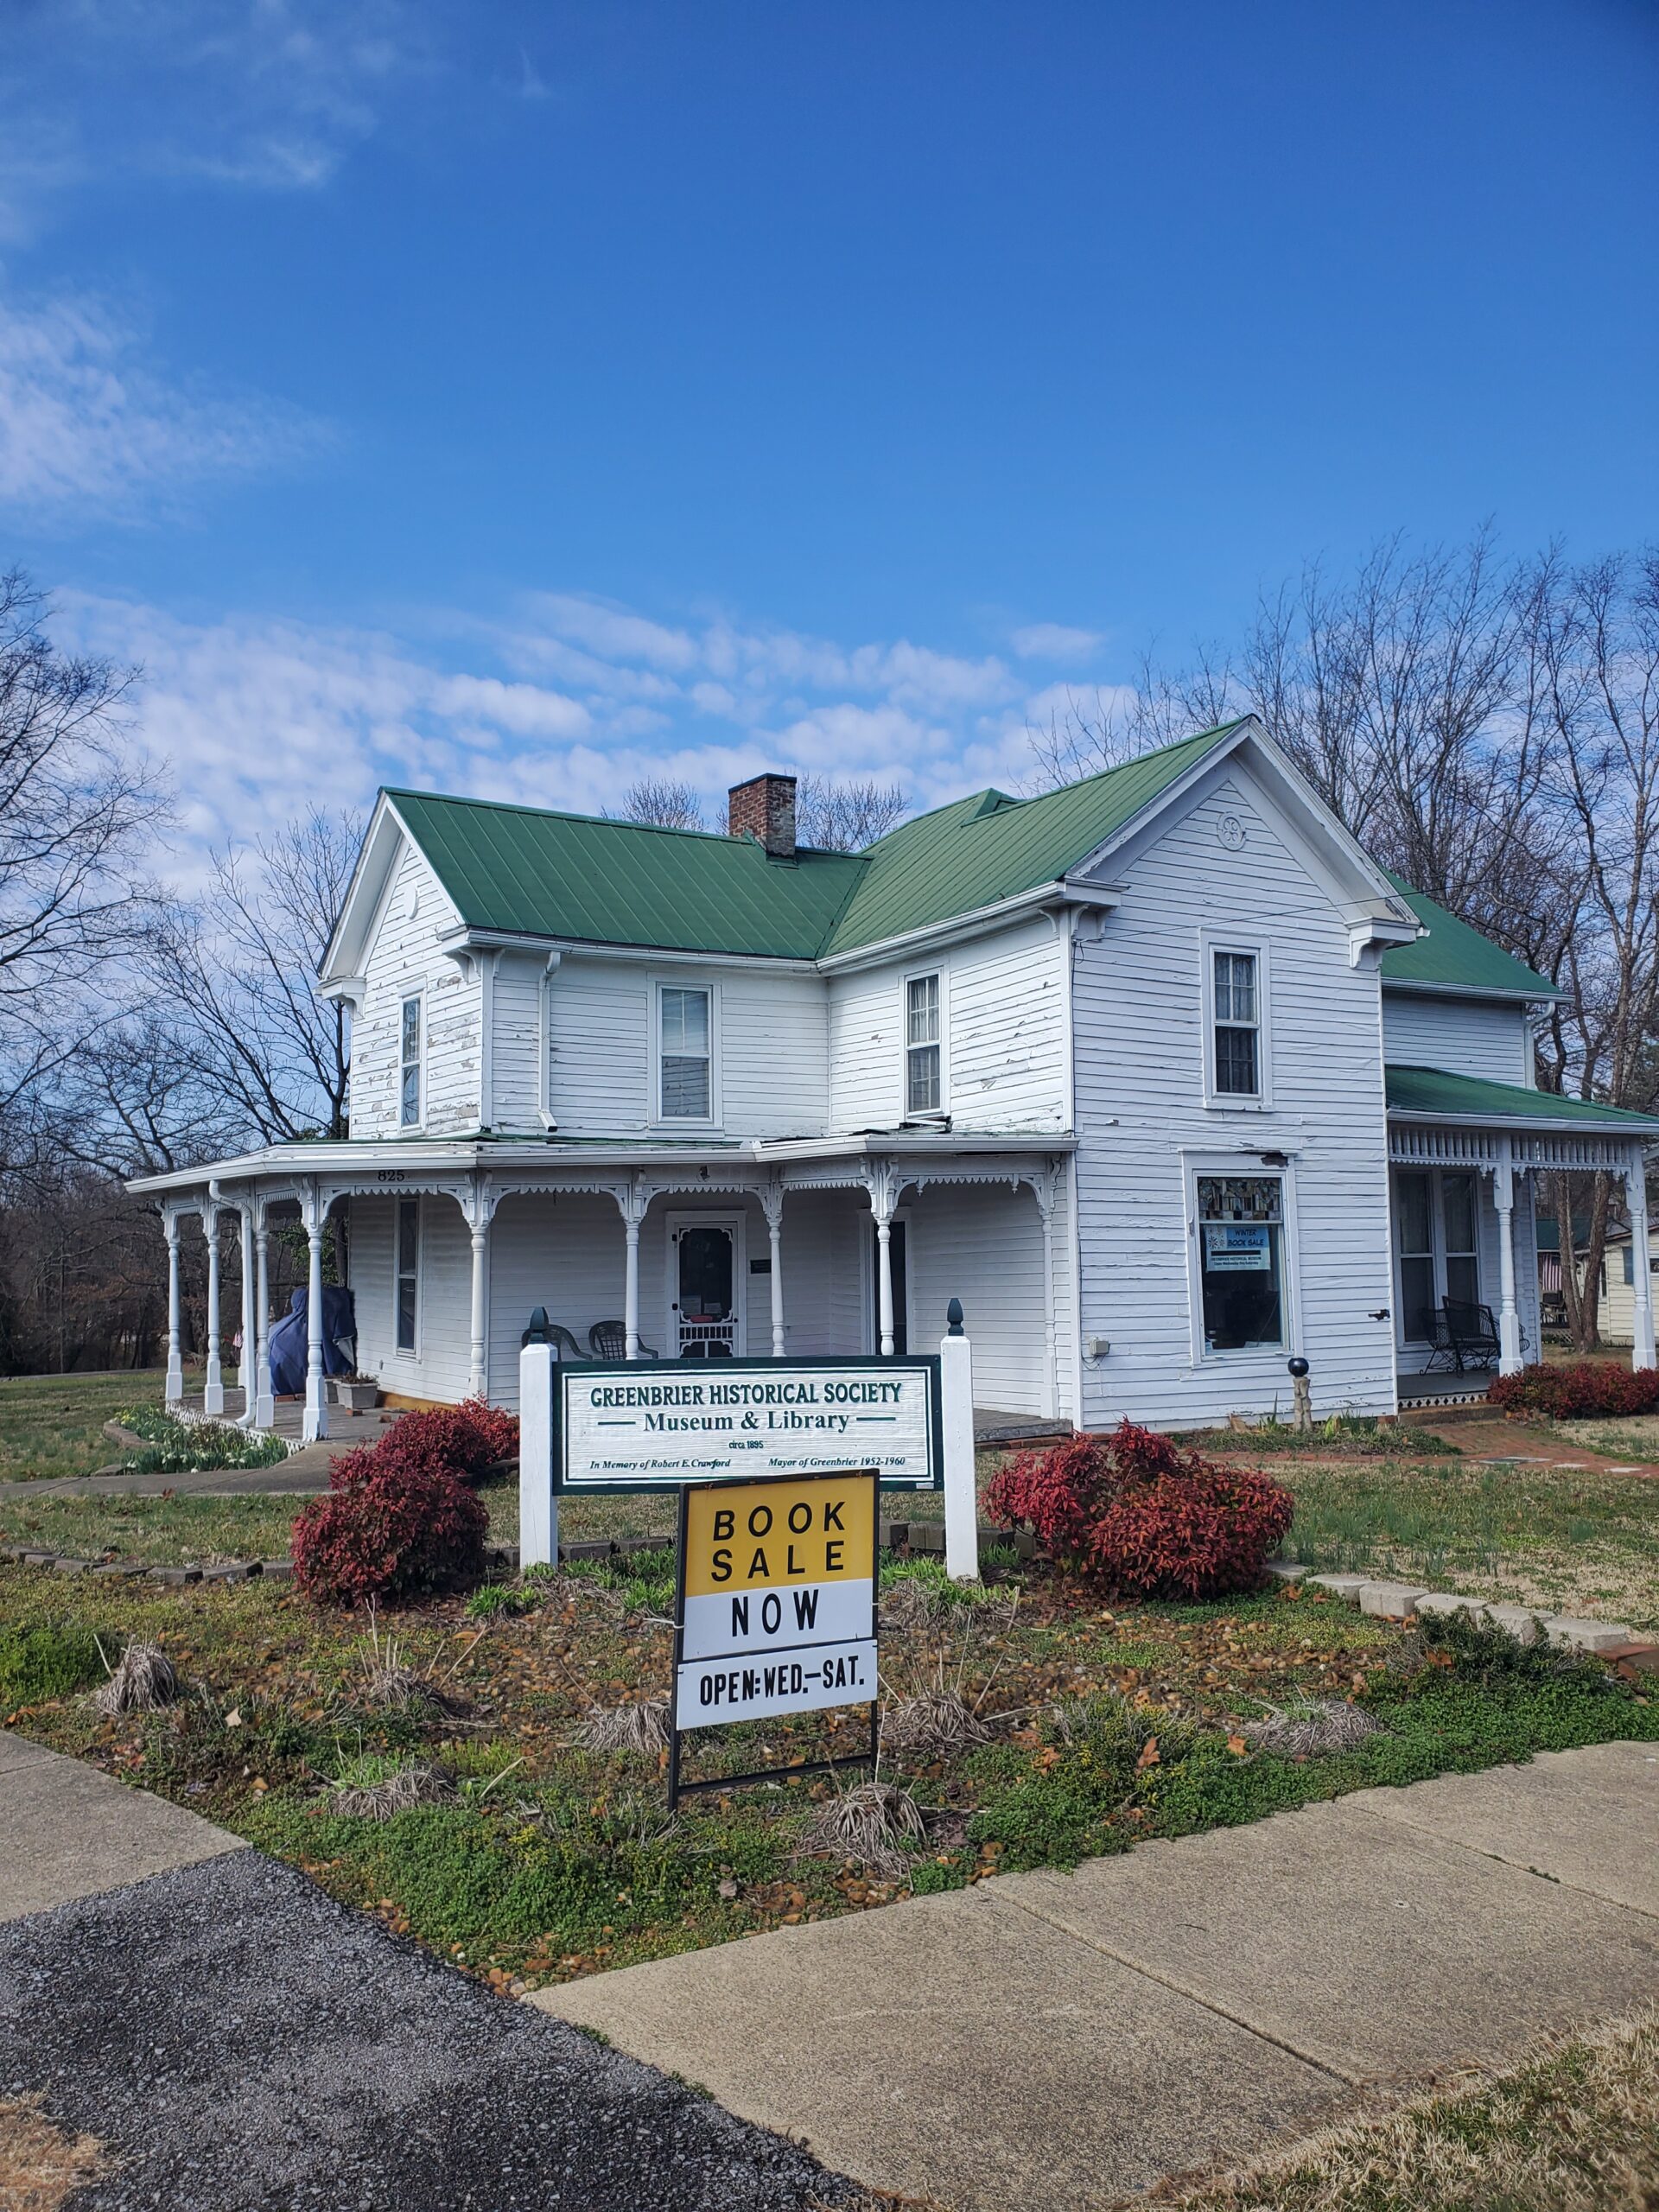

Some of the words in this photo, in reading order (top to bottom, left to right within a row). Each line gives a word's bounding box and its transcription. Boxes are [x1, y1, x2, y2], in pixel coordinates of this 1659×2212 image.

[378, 1170, 404, 1182] 825
[590, 1385, 704, 1407] GREENBRIER
[709, 1383, 819, 1404] HISTORICAL
[823, 1382, 901, 1403] SOCIETY
[643, 1413, 734, 1432] Museum
[741, 1411, 760, 1430] &
[767, 1410, 849, 1433] Library
[728, 1440, 745, 1449] circa
[747, 1440, 764, 1449] 1895
[590, 1460, 600, 1469] In
[602, 1460, 638, 1470] Memory
[639, 1459, 650, 1470] of
[651, 1459, 679, 1468] Robert
[682, 1459, 690, 1468] E.
[691, 1459, 732, 1470] Crawford
[768, 1458, 796, 1468] Mayor
[798, 1458, 810, 1468] of
[810, 1458, 858, 1466] Greenbrier
[860, 1456, 906, 1465] 1952-1960
[713, 1502, 845, 1541] BOOK
[711, 1541, 844, 1582] SALE
[732, 1589, 819, 1637] NOW
